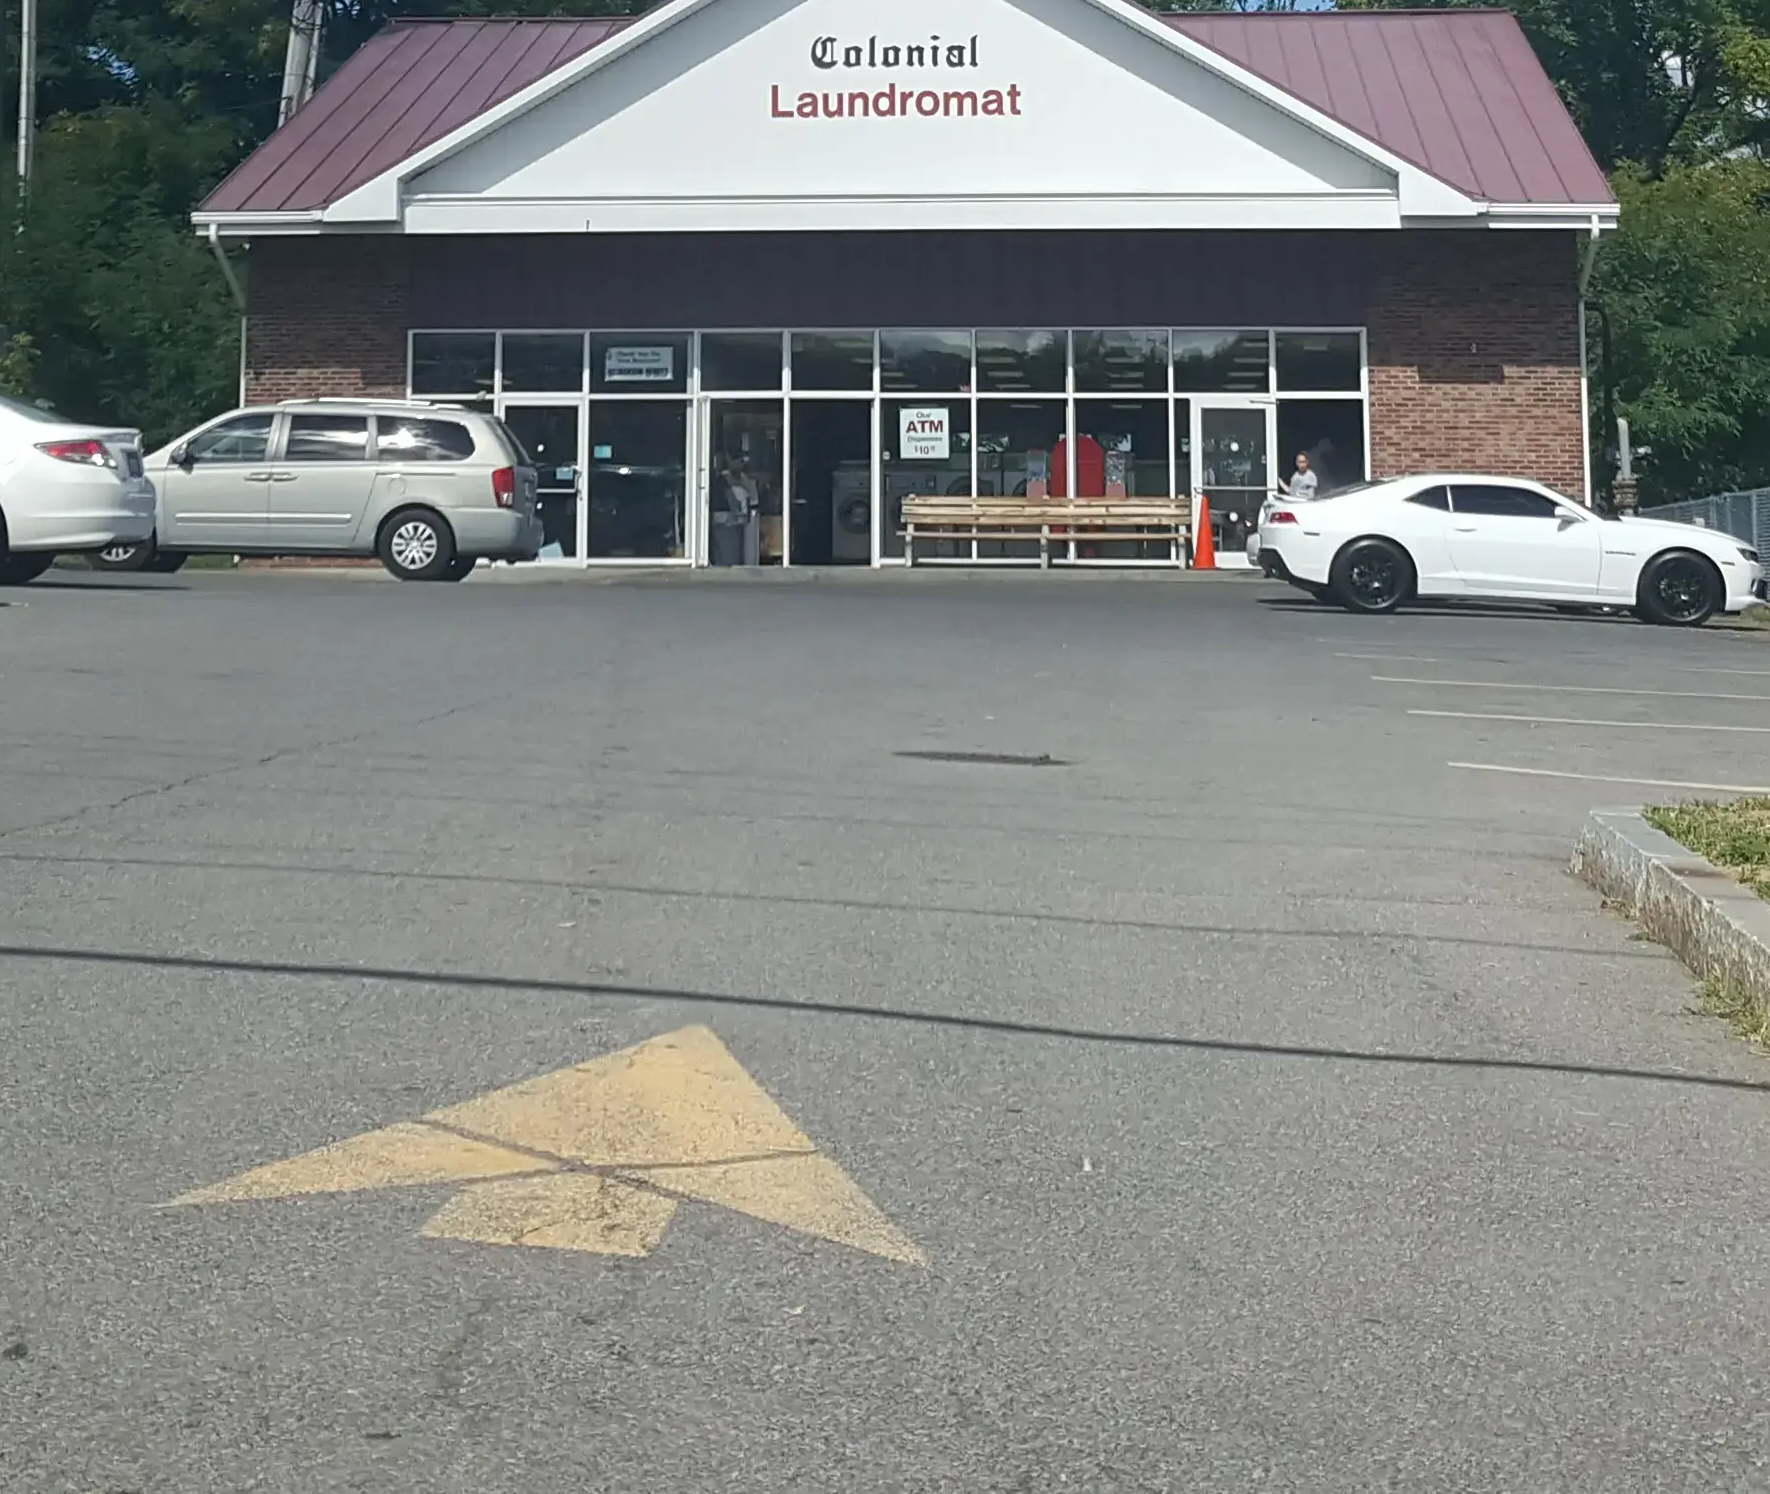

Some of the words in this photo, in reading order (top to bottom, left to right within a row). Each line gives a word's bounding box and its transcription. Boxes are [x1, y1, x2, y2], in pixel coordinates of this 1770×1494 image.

[810, 34, 979, 69] Colonial
[770, 82, 1022, 119] Laundromat
[905, 419, 944, 434] ATM
